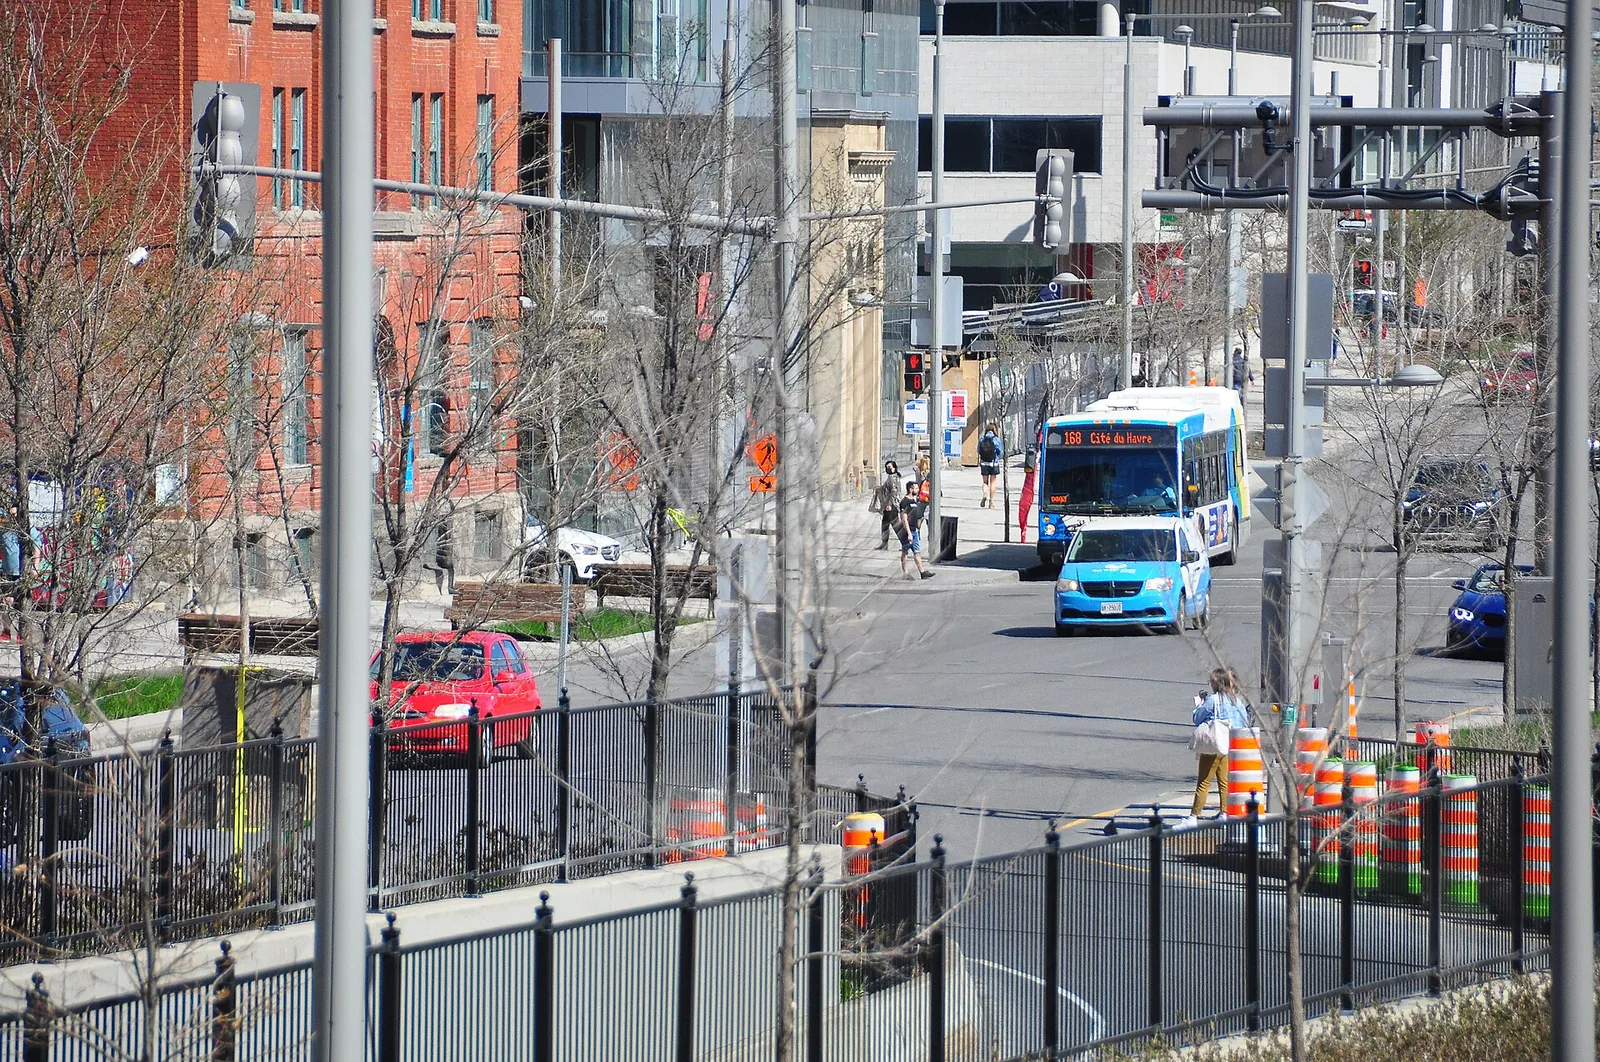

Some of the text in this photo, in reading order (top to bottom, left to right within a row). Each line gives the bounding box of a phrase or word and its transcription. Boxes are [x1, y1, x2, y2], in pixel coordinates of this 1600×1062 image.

[1064, 431, 1153, 445] 168 Cité du Havre
